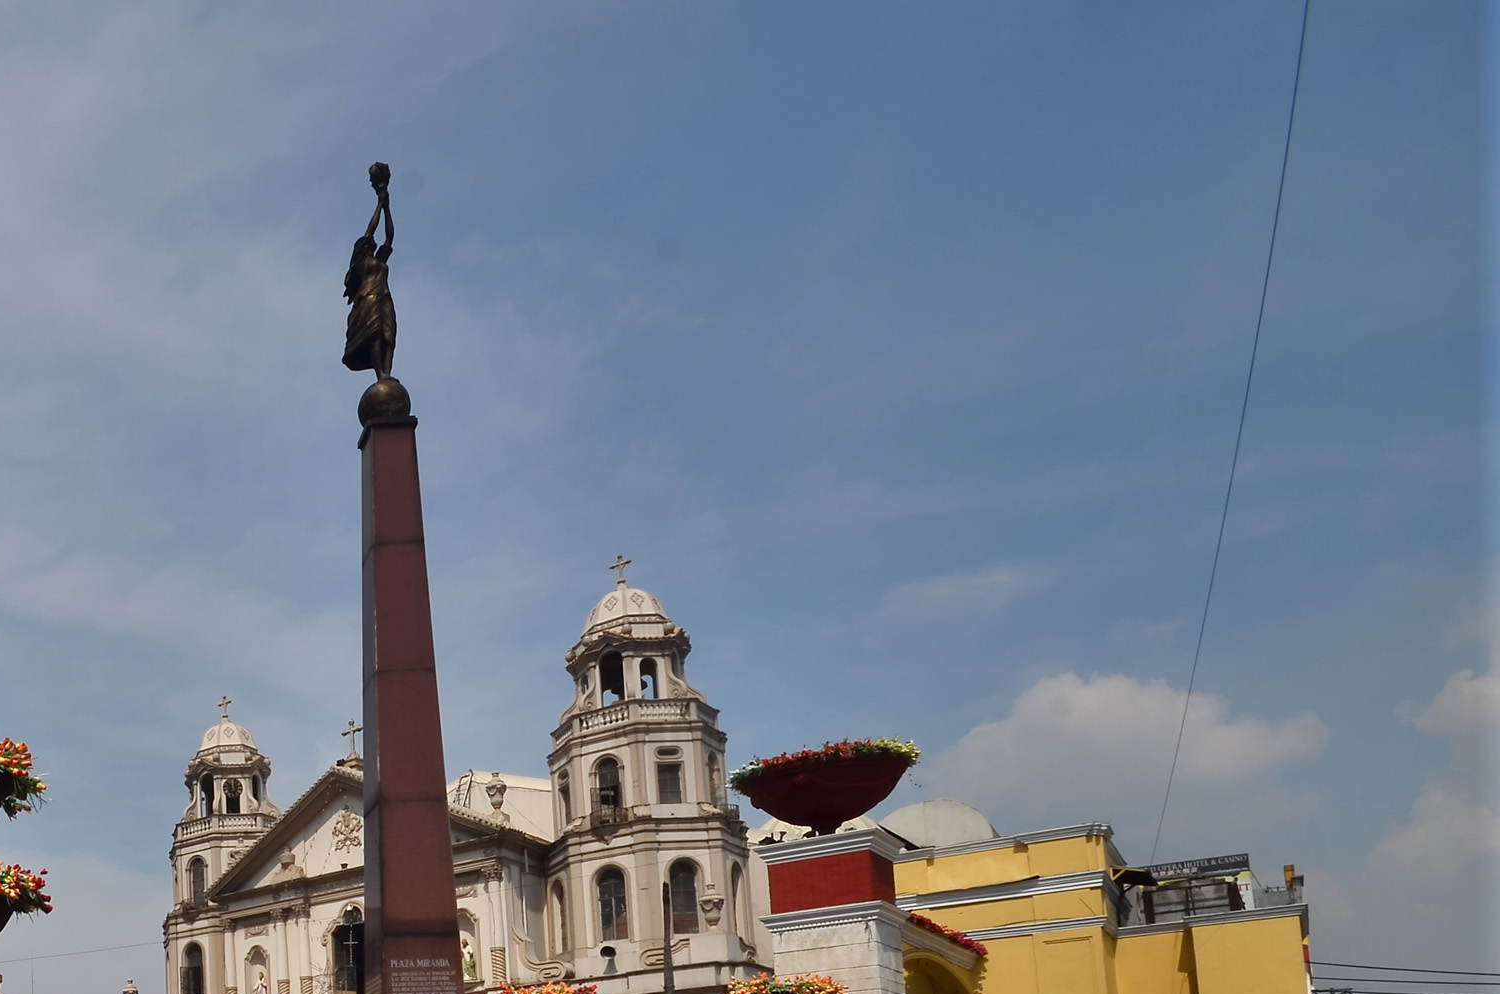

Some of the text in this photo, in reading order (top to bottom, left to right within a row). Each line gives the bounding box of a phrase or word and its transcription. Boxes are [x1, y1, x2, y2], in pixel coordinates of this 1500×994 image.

[1157, 861, 1183, 871] OPERA
[1184, 859, 1208, 869] HOTEL
[1218, 854, 1247, 864] CASINO
[390, 958, 450, 968] PLAZA MIRANDA
